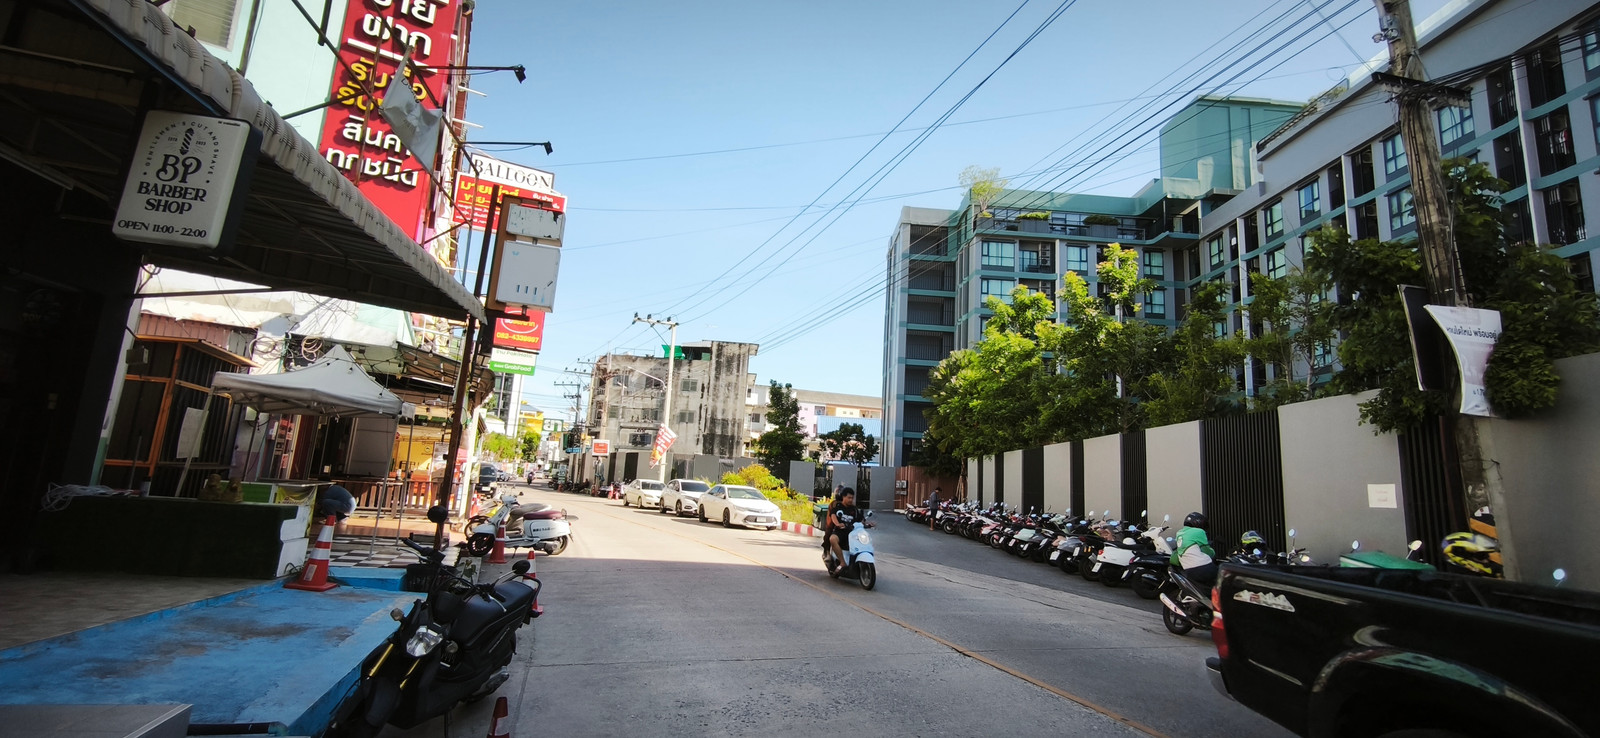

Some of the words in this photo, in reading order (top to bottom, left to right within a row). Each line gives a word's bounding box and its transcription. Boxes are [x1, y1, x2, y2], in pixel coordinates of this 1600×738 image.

[190, 121, 208, 131] CUT
[342, 114, 413, 158] สินค
[208, 131, 219, 146] AND
[156, 153, 202, 184] BP
[207, 149, 220, 175] SHAVE
[326, 147, 419, 187] ทกชนิด
[474, 158, 551, 190] BALLOON
[137, 181, 207, 202] BARBER
[144, 198, 193, 215] SHOP
[117, 219, 151, 231] OPEN
[180, 227, 207, 239] 22:00
